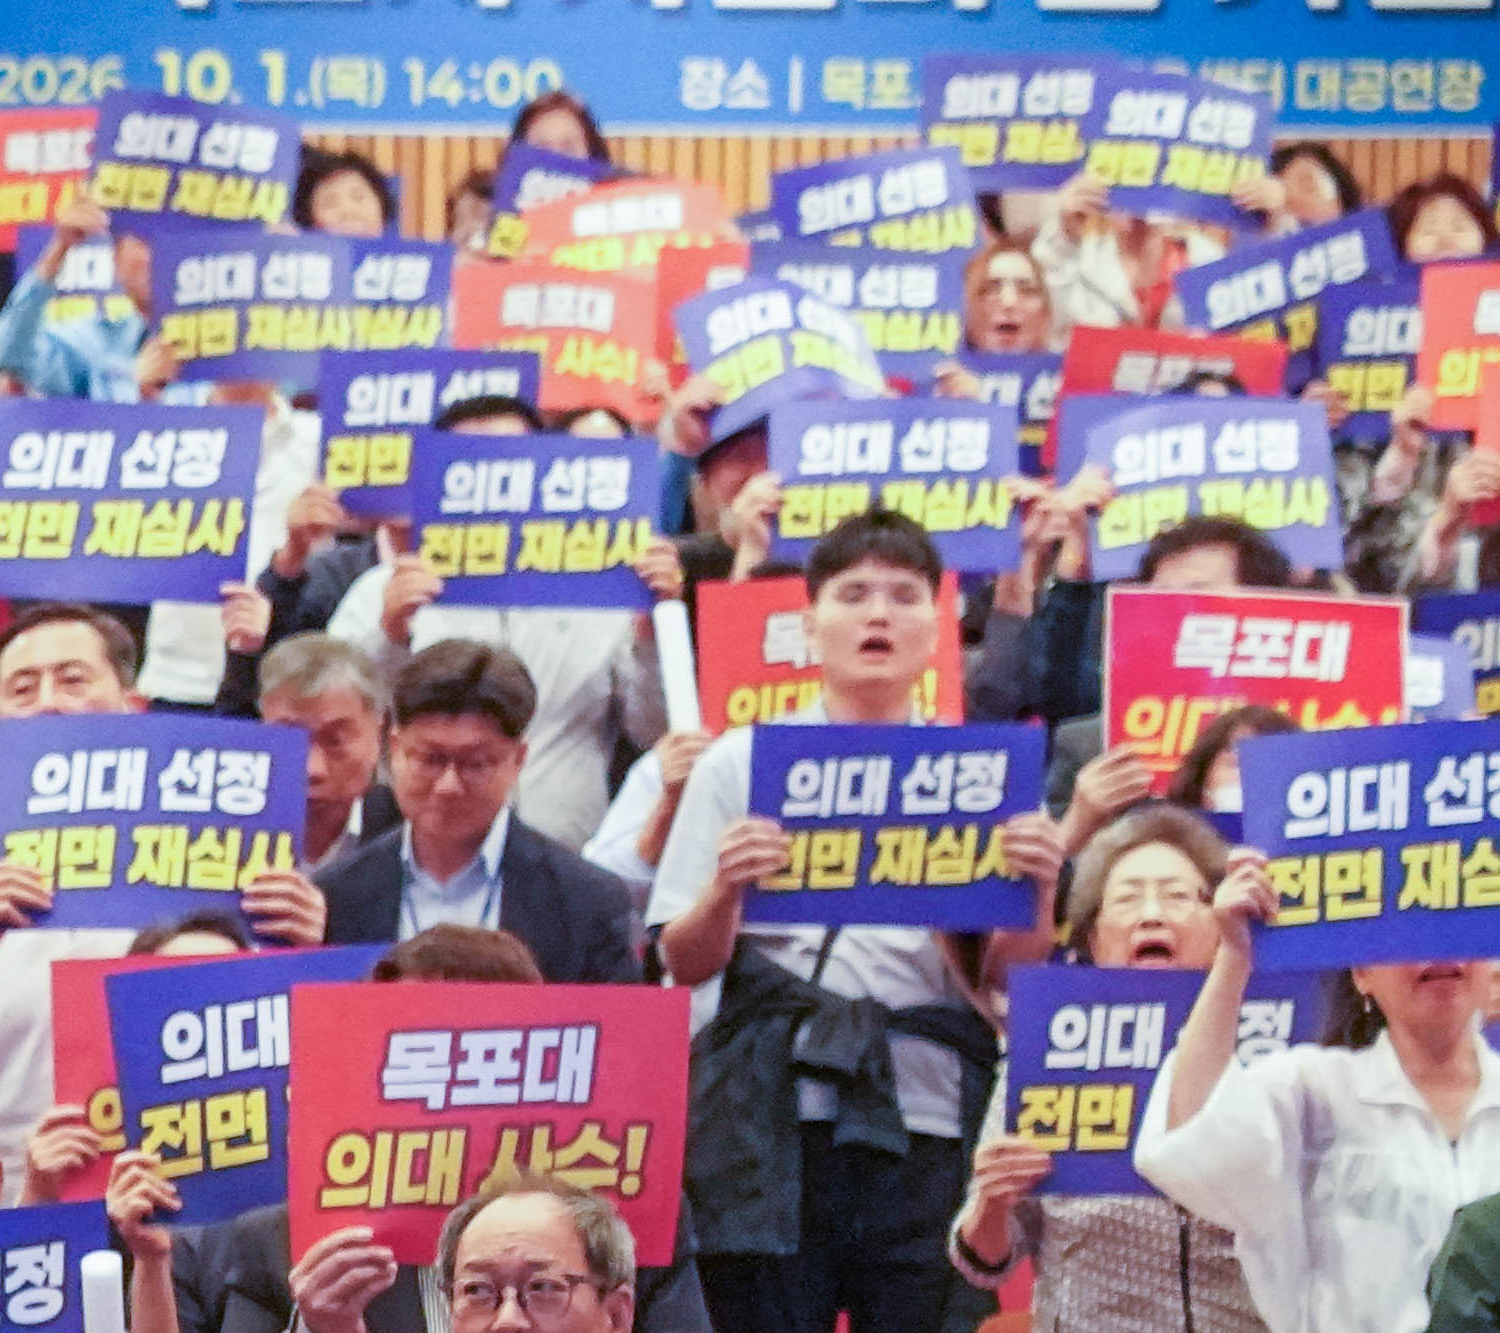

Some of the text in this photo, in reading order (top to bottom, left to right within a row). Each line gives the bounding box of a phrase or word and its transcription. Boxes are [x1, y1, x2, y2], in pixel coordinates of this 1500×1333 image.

[3, 429, 228, 489] 의대 선정
[799, 423, 893, 474] 의대
[86, 500, 243, 556] 재심사
[1176, 616, 1350, 680] 목포대
[27, 749, 270, 814] 의대 선정
[782, 751, 1007, 817] 의대 선정
[1285, 762, 1409, 838] 의대
[128, 827, 305, 898] 재심사
[1256, 851, 1382, 924] 전면
[162, 995, 290, 1083] 의대
[383, 1027, 596, 1109] 목포대
[1046, 1003, 1165, 1070] 의대
[130, 1091, 268, 1190] 전면
[1008, 1086, 1133, 1159] 전면
[322, 1130, 465, 1207] 의대
